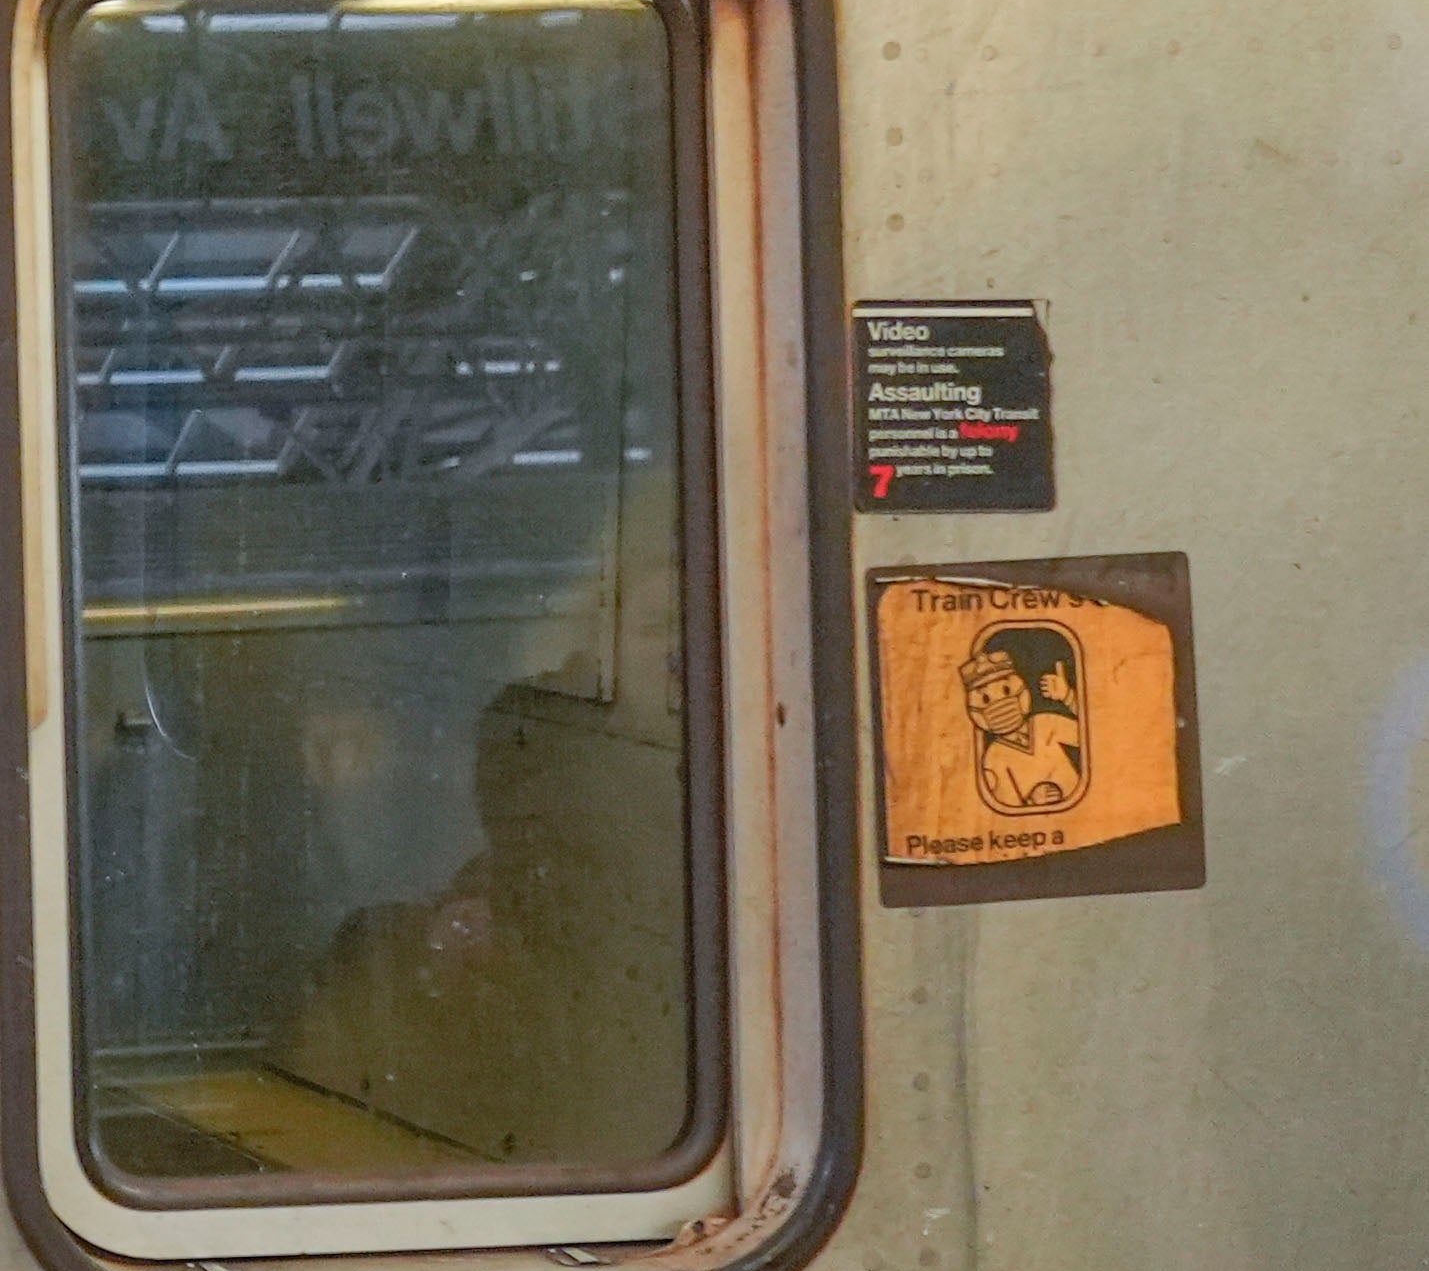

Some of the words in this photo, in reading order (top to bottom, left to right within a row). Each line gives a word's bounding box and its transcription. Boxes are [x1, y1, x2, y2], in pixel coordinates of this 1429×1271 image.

[867, 320, 930, 341] Video
[867, 382, 982, 406] Assaulting
[868, 408, 900, 421] MTA
[868, 465, 895, 498] 7
[910, 589, 983, 612] Train
[906, 834, 984, 855] Please
[988, 830, 1047, 850] keep
[1051, 830, 1064, 845] a
